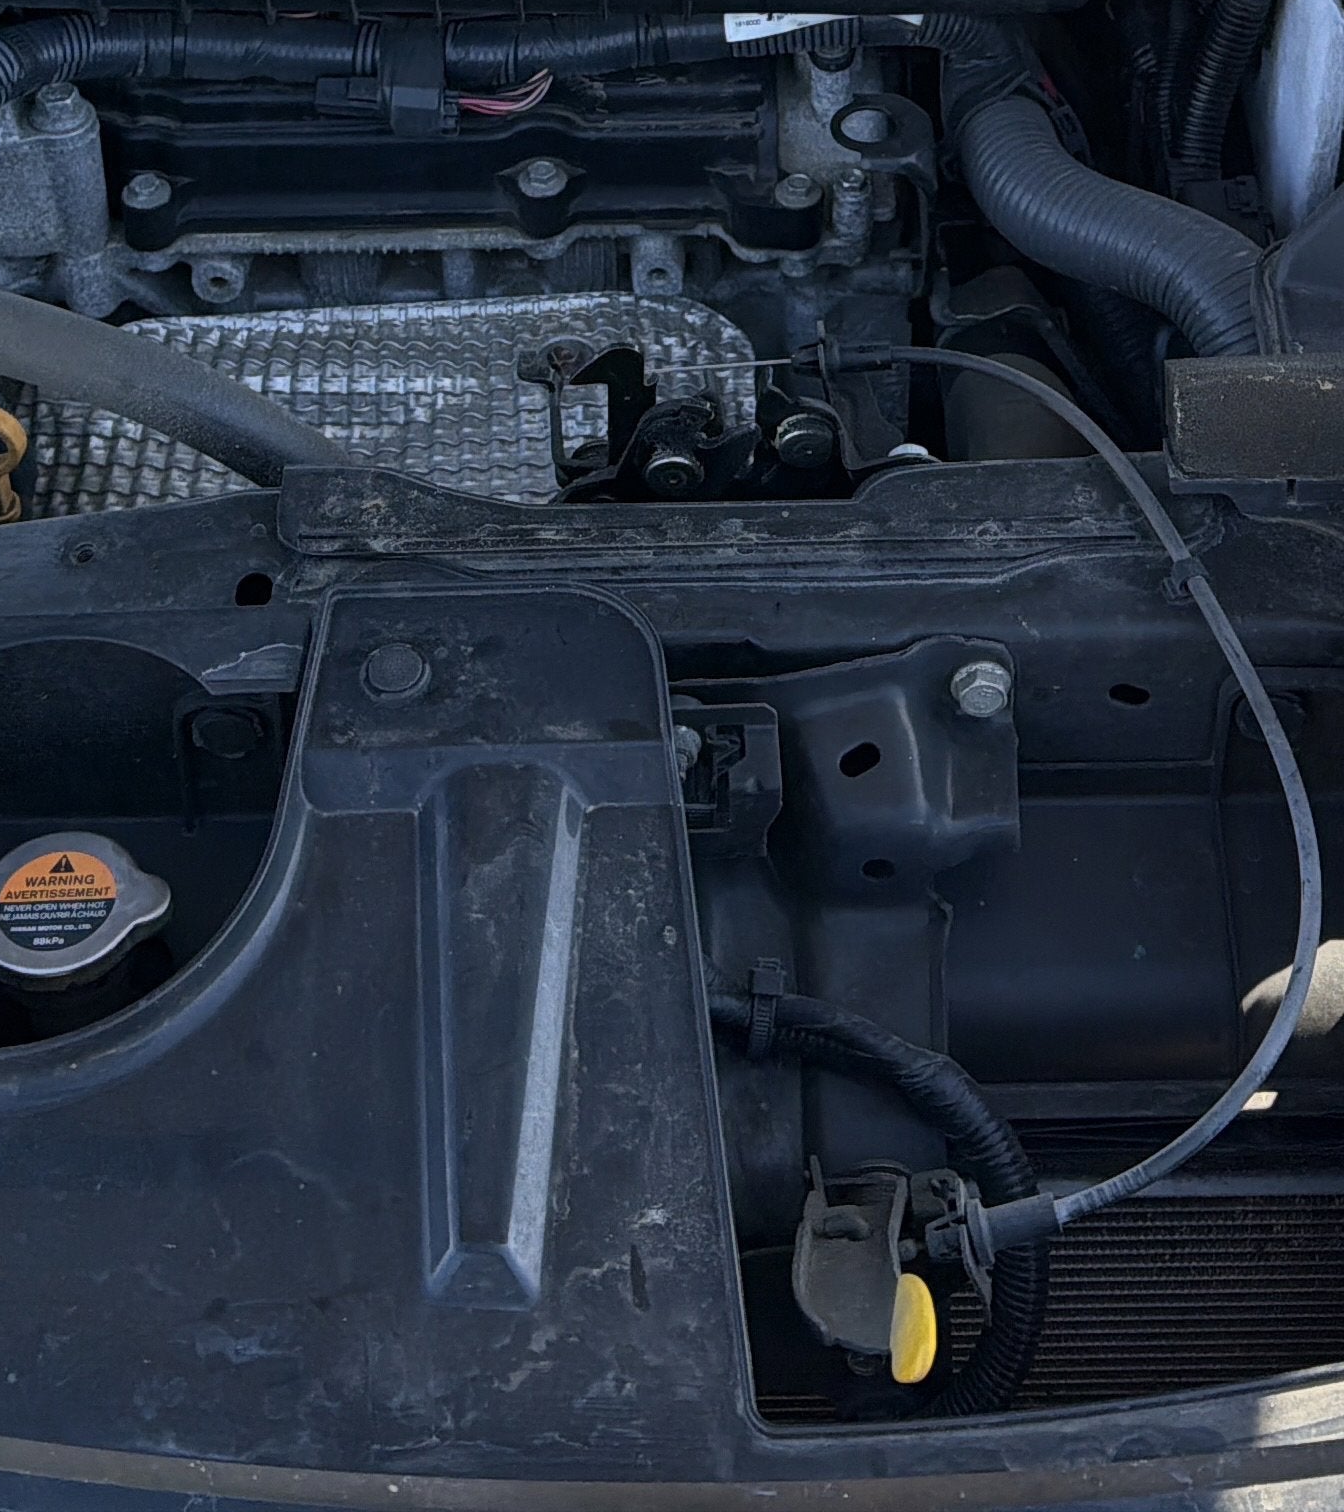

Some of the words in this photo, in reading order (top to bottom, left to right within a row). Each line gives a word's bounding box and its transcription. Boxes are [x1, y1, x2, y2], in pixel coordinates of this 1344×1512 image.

[25, 874, 95, 888] WARNING
[4, 886, 111, 900] AVERTISSEMENT
[3, 904, 32, 912] NEVER
[33, 903, 56, 911] OPEN
[59, 902, 85, 910] WHEN
[0, 913, 10, 921] NE
[11, 912, 38, 920] JAMAIS
[76, 909, 106, 918] CHAUD
[33, 936, 64, 946] 88kPa
